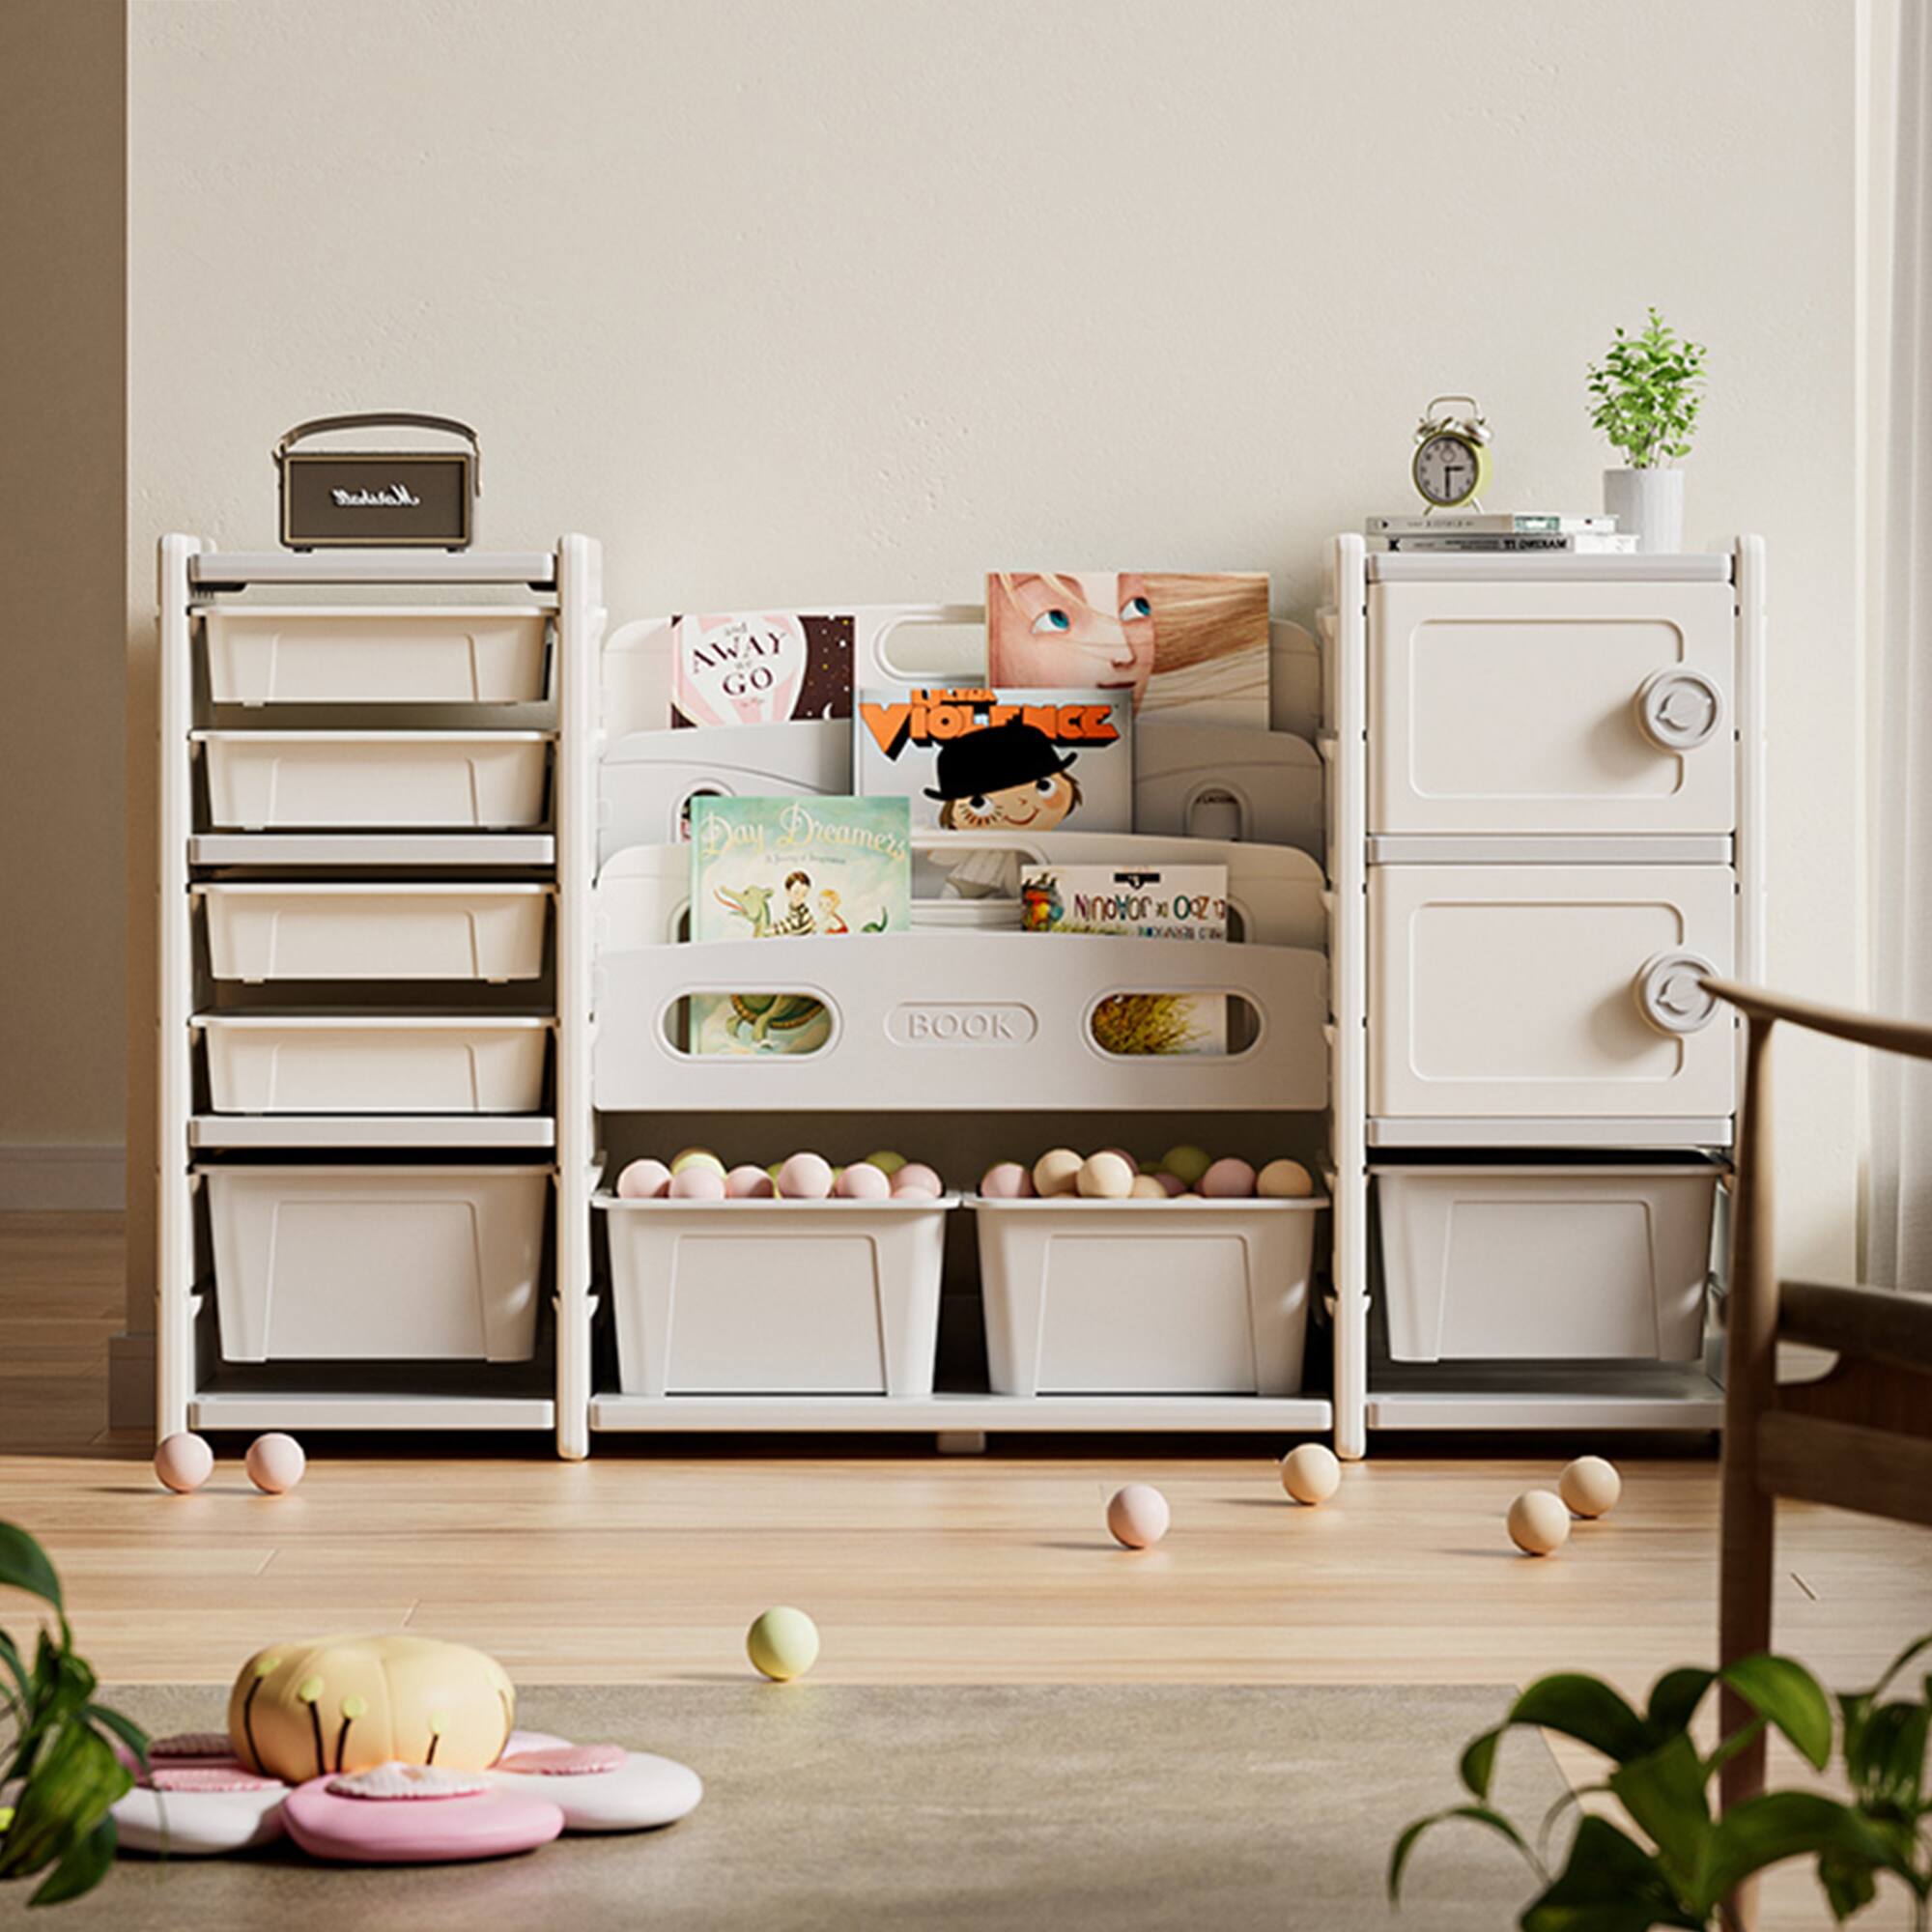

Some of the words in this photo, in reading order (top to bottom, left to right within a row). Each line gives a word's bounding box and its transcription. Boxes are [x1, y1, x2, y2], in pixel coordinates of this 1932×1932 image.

[693, 631, 787, 673] AWAY
[723, 666, 774, 696] GO
[698, 811, 764, 857] Day
[775, 801, 907, 862] Dreamers
[1173, 895, 1209, 921] ZOO
[908, 1013, 1013, 1039] BOOK
